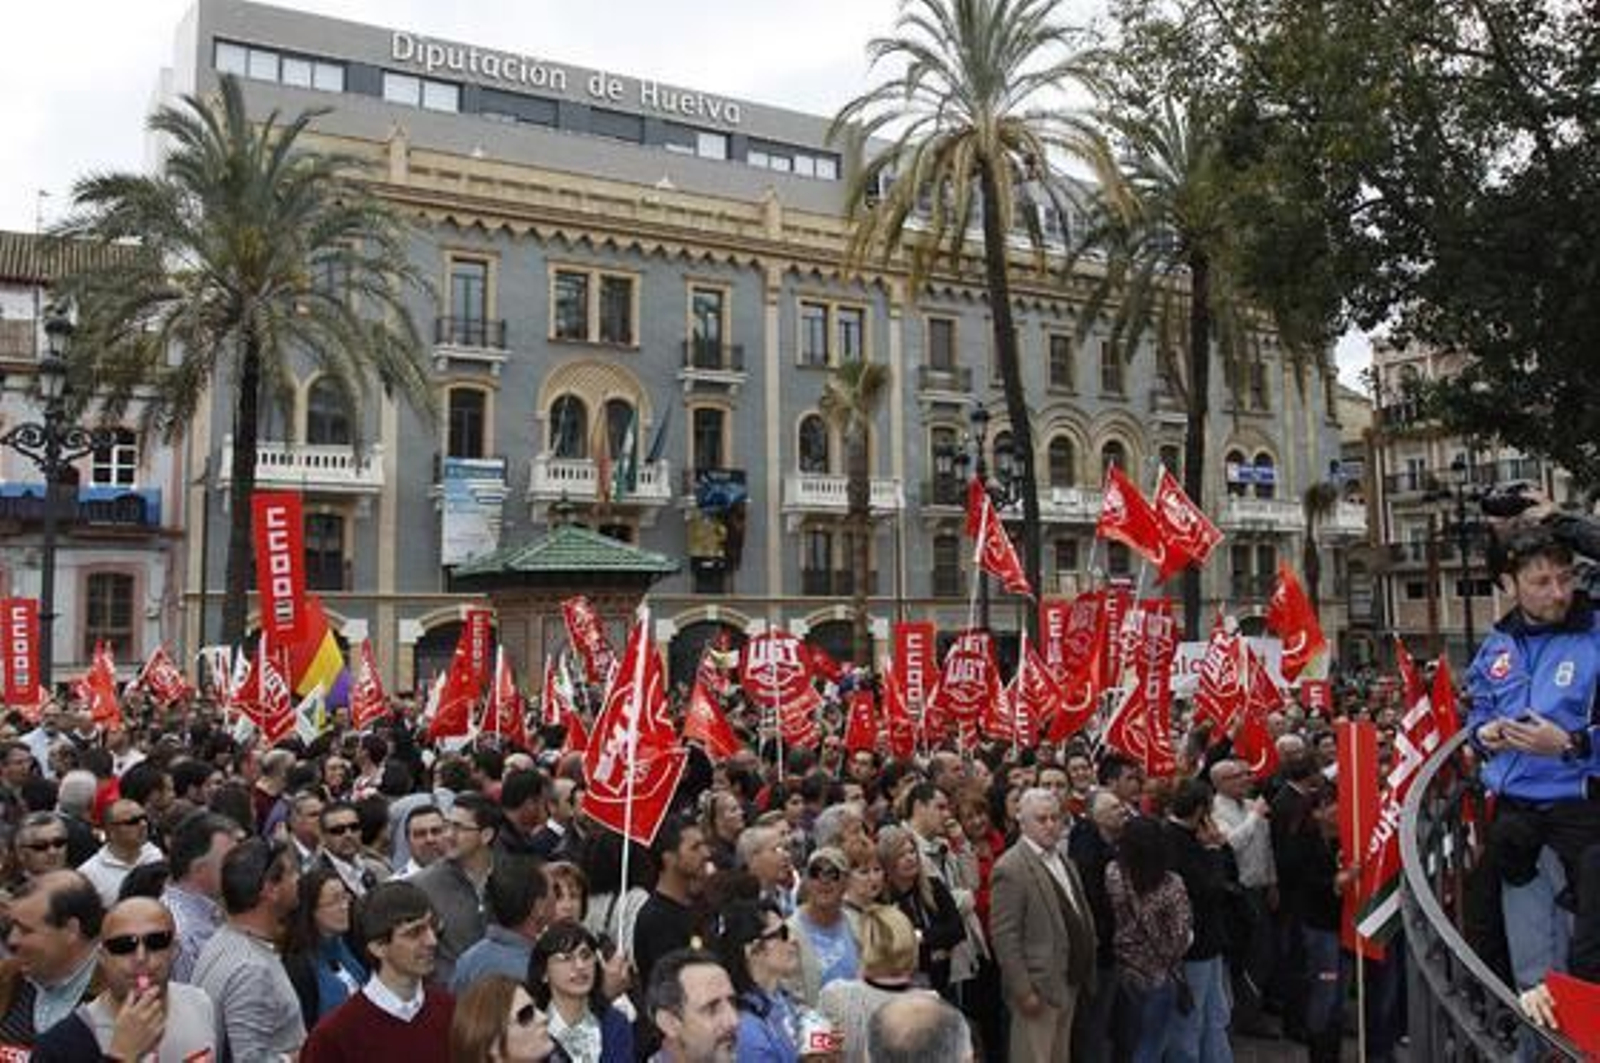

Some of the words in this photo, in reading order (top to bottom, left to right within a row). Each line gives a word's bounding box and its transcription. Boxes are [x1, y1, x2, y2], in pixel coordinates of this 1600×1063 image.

[589, 70, 623, 99] de
[640, 79, 741, 124] Huelva
[266, 506, 293, 598] CCOO
[11, 606, 29, 669] CCOO
[748, 638, 799, 666] UGT
[907, 632, 923, 702] CCOO
[945, 657, 986, 685] UGT
